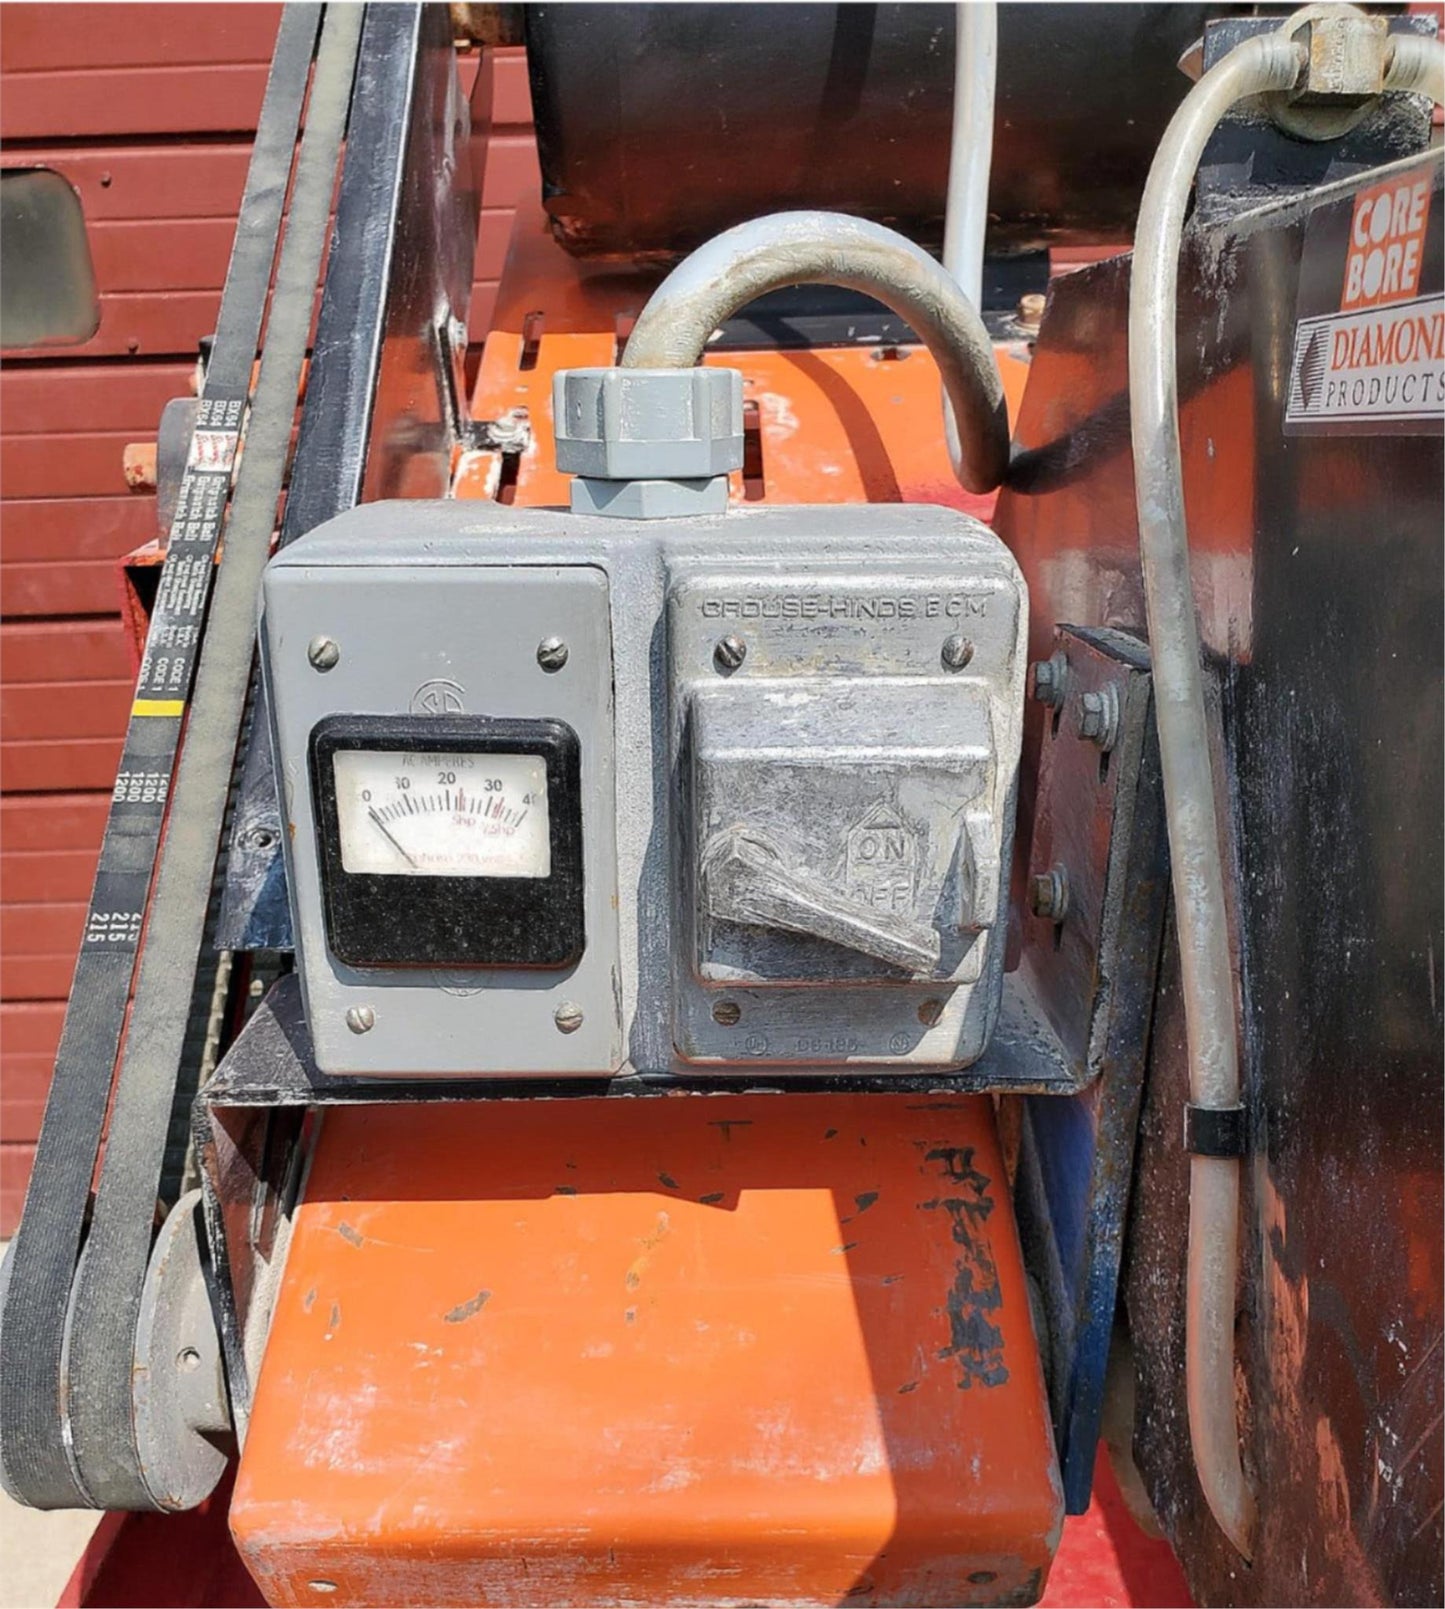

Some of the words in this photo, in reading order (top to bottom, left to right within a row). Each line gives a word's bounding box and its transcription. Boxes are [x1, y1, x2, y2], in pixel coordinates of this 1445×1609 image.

[1353, 181, 1428, 248] CORE
[1345, 238, 1421, 303] BORE
[153, 657, 169, 684] CODE
[169, 657, 185, 684] CODE
[113, 771, 130, 802] 1200
[127, 771, 144, 803] 1200
[141, 771, 159, 803] 1200
[438, 771, 456, 785] 20
[484, 778, 503, 792] 30
[361, 789, 372, 802] 0
[858, 836, 905, 860] ON
[87, 912, 110, 942] 215
[107, 912, 130, 942] 215
